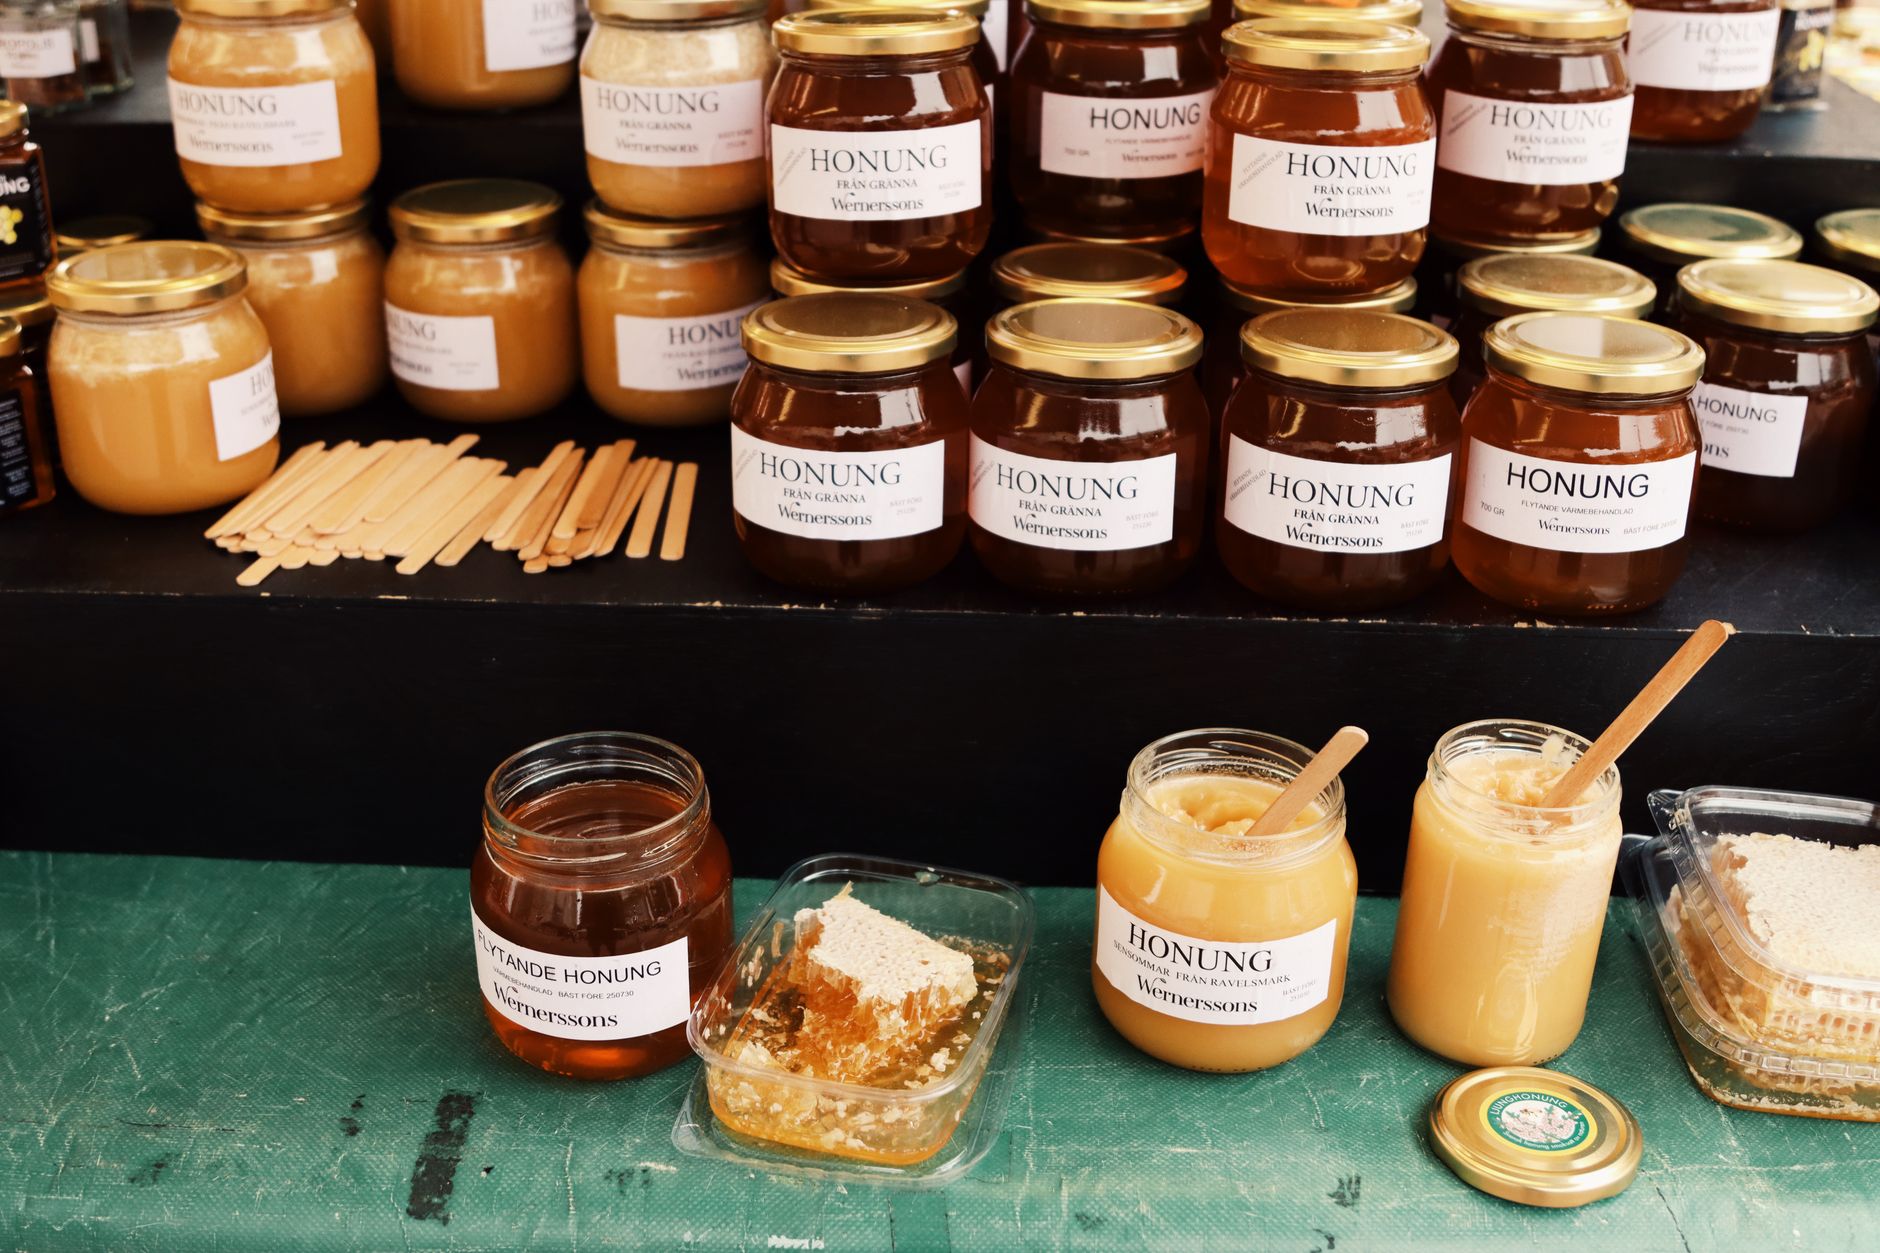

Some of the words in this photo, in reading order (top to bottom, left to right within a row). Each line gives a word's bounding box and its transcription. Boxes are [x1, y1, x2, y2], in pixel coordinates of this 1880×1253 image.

[178, 89, 277, 116] HONUNG
[597, 87, 719, 114] HONUNG
[1090, 103, 1201, 130] HONUNG
[1490, 105, 1612, 131] HONUNG
[810, 145, 948, 173] HONUNG
[1286, 152, 1417, 180] HONUNG
[837, 178, 866, 190] FRÅN
[1314, 184, 1344, 195] FRÅN
[831, 196, 923, 212] Wernerssons
[1305, 201, 1394, 218] Wernerssons
[668, 315, 744, 345] HONU
[1696, 396, 1778, 424] HONUNG
[760, 451, 901, 487] HONUNG
[996, 463, 1138, 501] HONUNG
[1506, 462, 1649, 499] HONUNG
[783, 487, 812, 501] FRÅN
[815, 492, 866, 504] GRÄNNA
[1268, 472, 1415, 508] HONUNG
[777, 504, 873, 526] Wernerssons
[1019, 499, 1048, 513] FRÅN
[1050, 503, 1102, 517] GRÄNNA
[1294, 508, 1325, 523] FRÅN
[1328, 512, 1380, 525] GRÄNNA
[1480, 501, 1492, 512] 700
[1493, 506, 1505, 517] GR
[1521, 500, 1559, 512] FLYTANDE
[1013, 515, 1108, 539] Wernerssons
[1285, 524, 1383, 548] Wernerssons
[1538, 519, 1610, 535] Wernerssons
[477, 929, 557, 982] FLYTANDE
[564, 961, 662, 985] HONUNG
[1113, 939, 1170, 977] SENSOMMAR
[1128, 921, 1272, 973] HONUNG
[493, 980, 619, 1028] Wernerssons
[606, 990, 634, 999] 250730
[1136, 974, 1258, 1013] Wernerssons
[1490, 1093, 1567, 1115] LJUNGHONUNG
